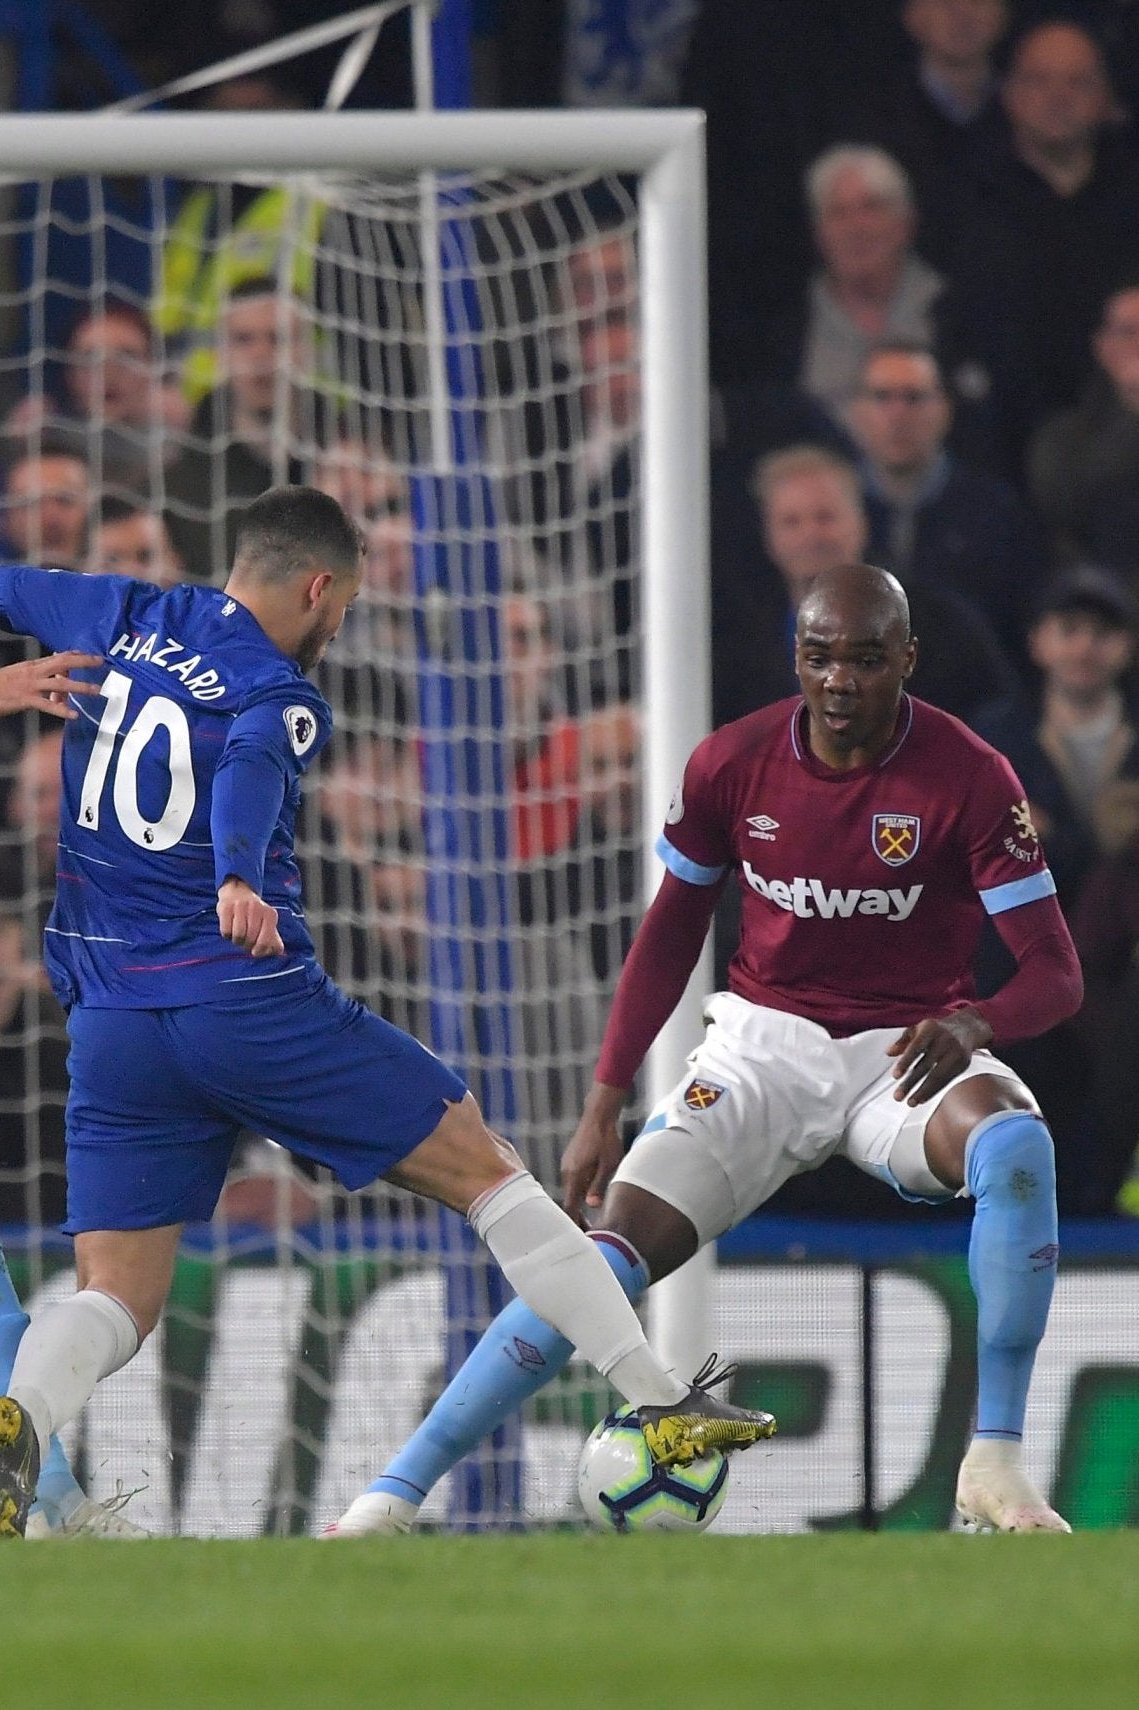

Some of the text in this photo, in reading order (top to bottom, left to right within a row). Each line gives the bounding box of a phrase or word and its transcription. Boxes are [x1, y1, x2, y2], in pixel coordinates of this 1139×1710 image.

[109, 633, 226, 700] HAZARD
[77, 670, 196, 851] 10
[742, 860, 924, 921] betway
